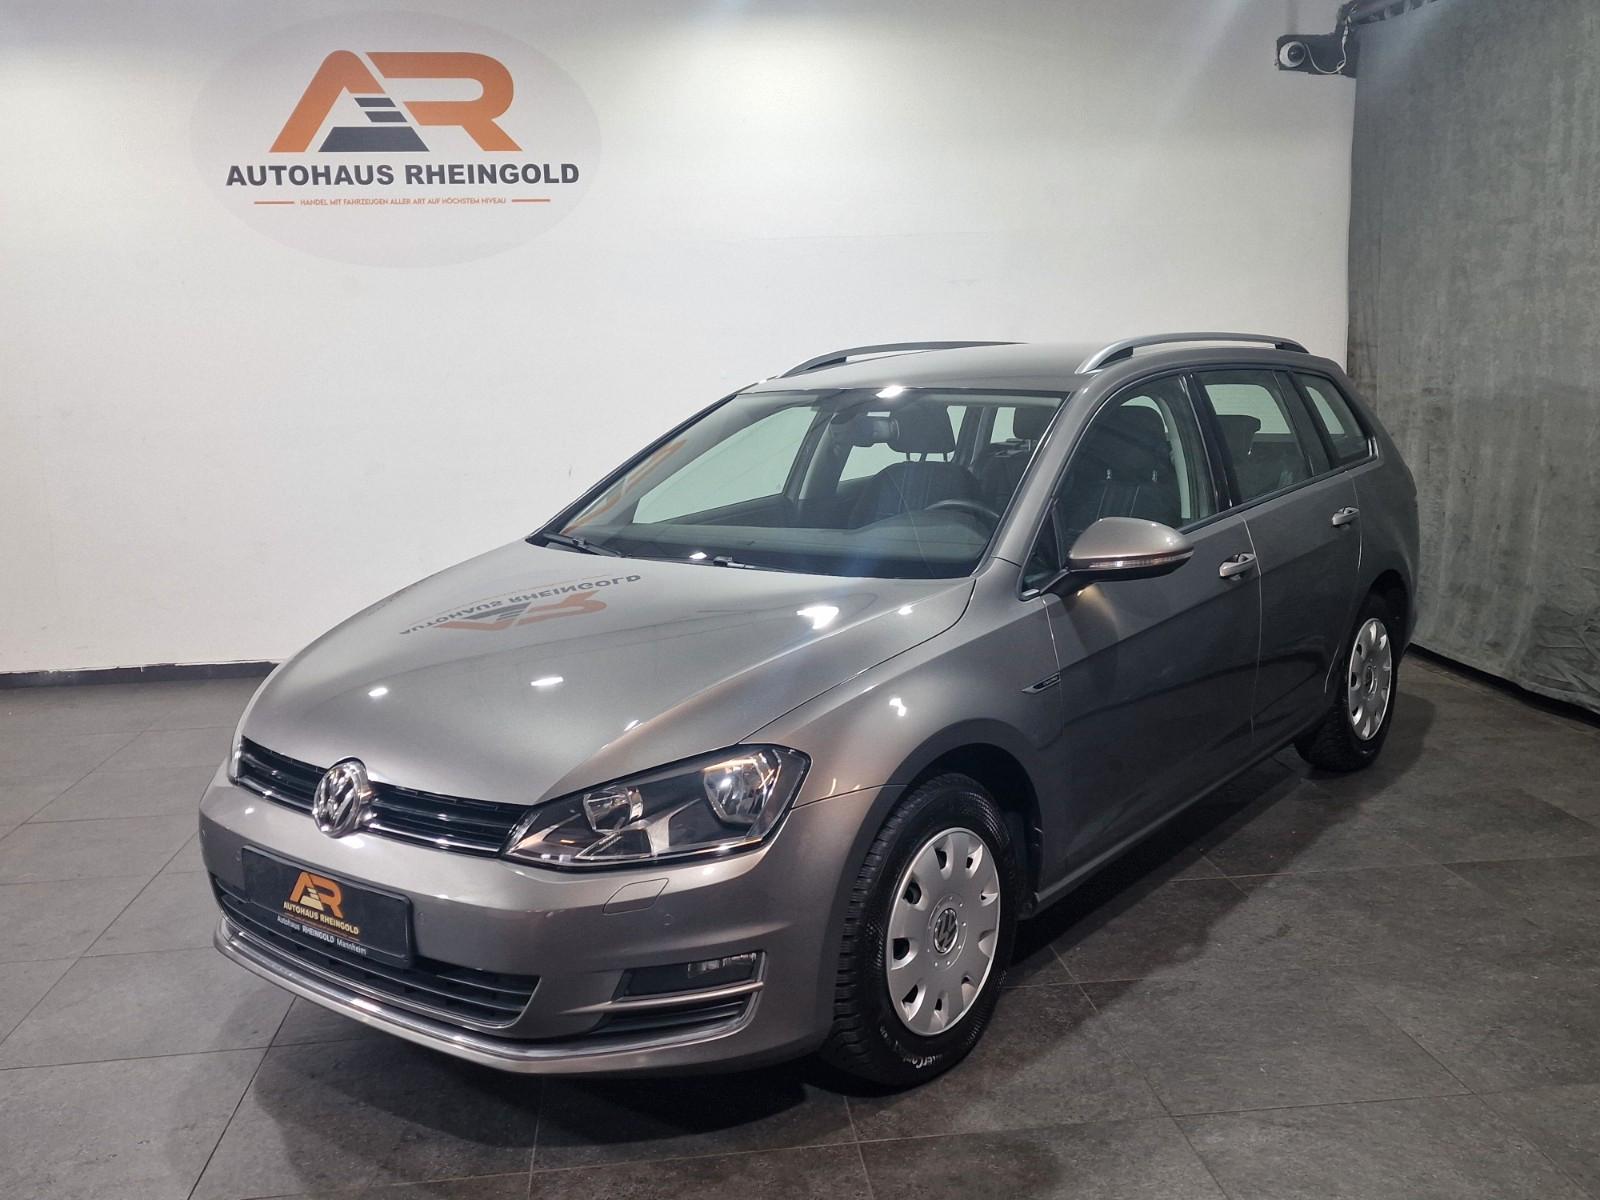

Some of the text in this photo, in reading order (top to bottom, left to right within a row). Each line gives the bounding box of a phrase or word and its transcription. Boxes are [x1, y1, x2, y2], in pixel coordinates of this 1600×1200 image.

[226, 163, 580, 186] AUTOHAUS RHEINGOLD
[300, 196, 506, 206] HANDEL MIT FAHRZEUGEN ALLER ART AUF HÖCHSTEM NIVEAU
[283, 900, 360, 935] AUTOHAUS RHEINGOLD
[277, 915, 367, 955] Autohaus RHEINGOLD Mannheim
